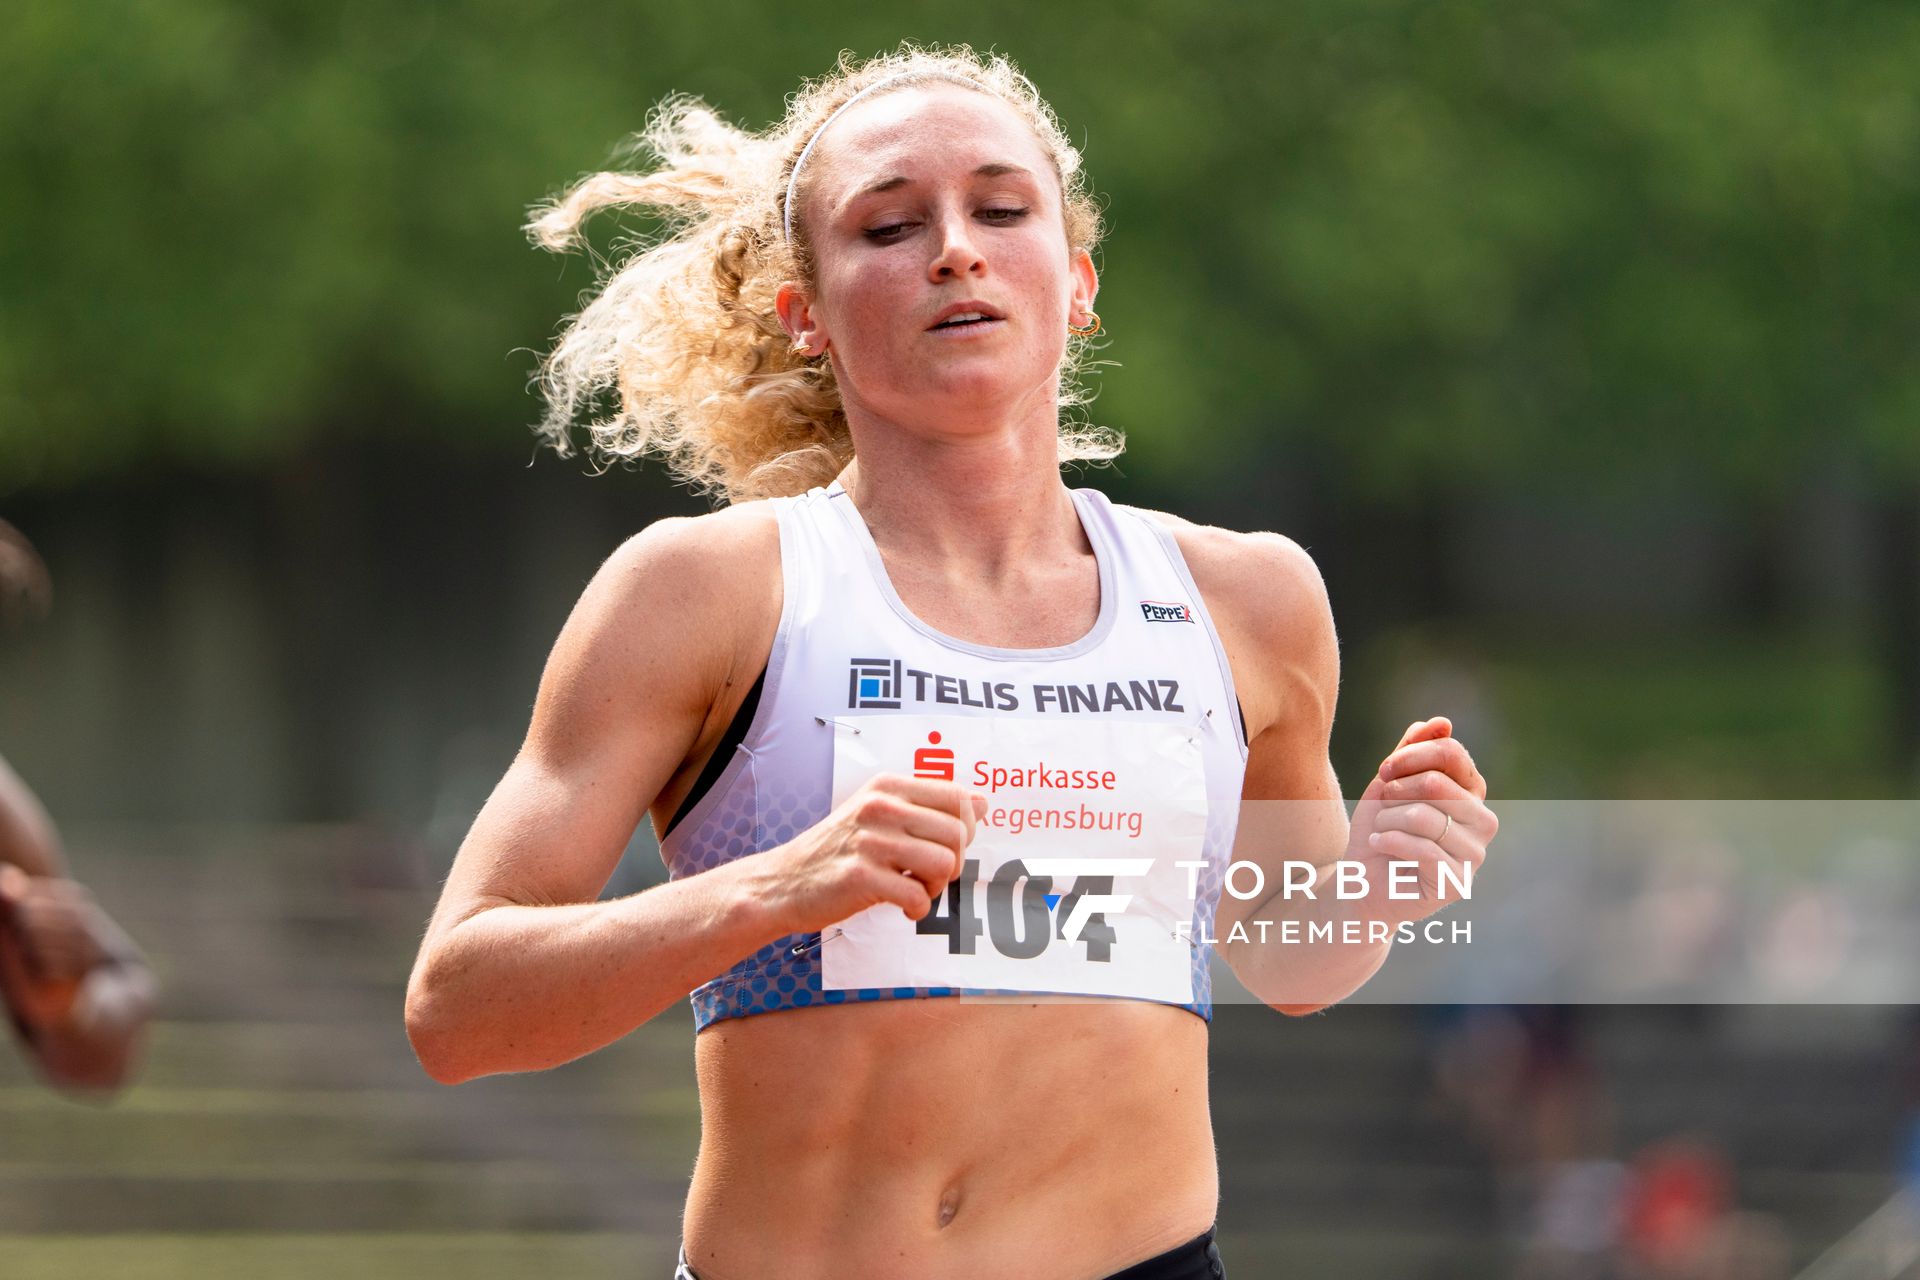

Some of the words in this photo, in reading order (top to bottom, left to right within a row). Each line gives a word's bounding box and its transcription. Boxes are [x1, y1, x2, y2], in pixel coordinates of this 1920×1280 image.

[907, 669, 1019, 711] TELIS
[1033, 679, 1185, 713] FINANZ
[972, 761, 1117, 793] Sparkasse
[978, 804, 1143, 838] egensburg
[916, 858, 1117, 963] 404
